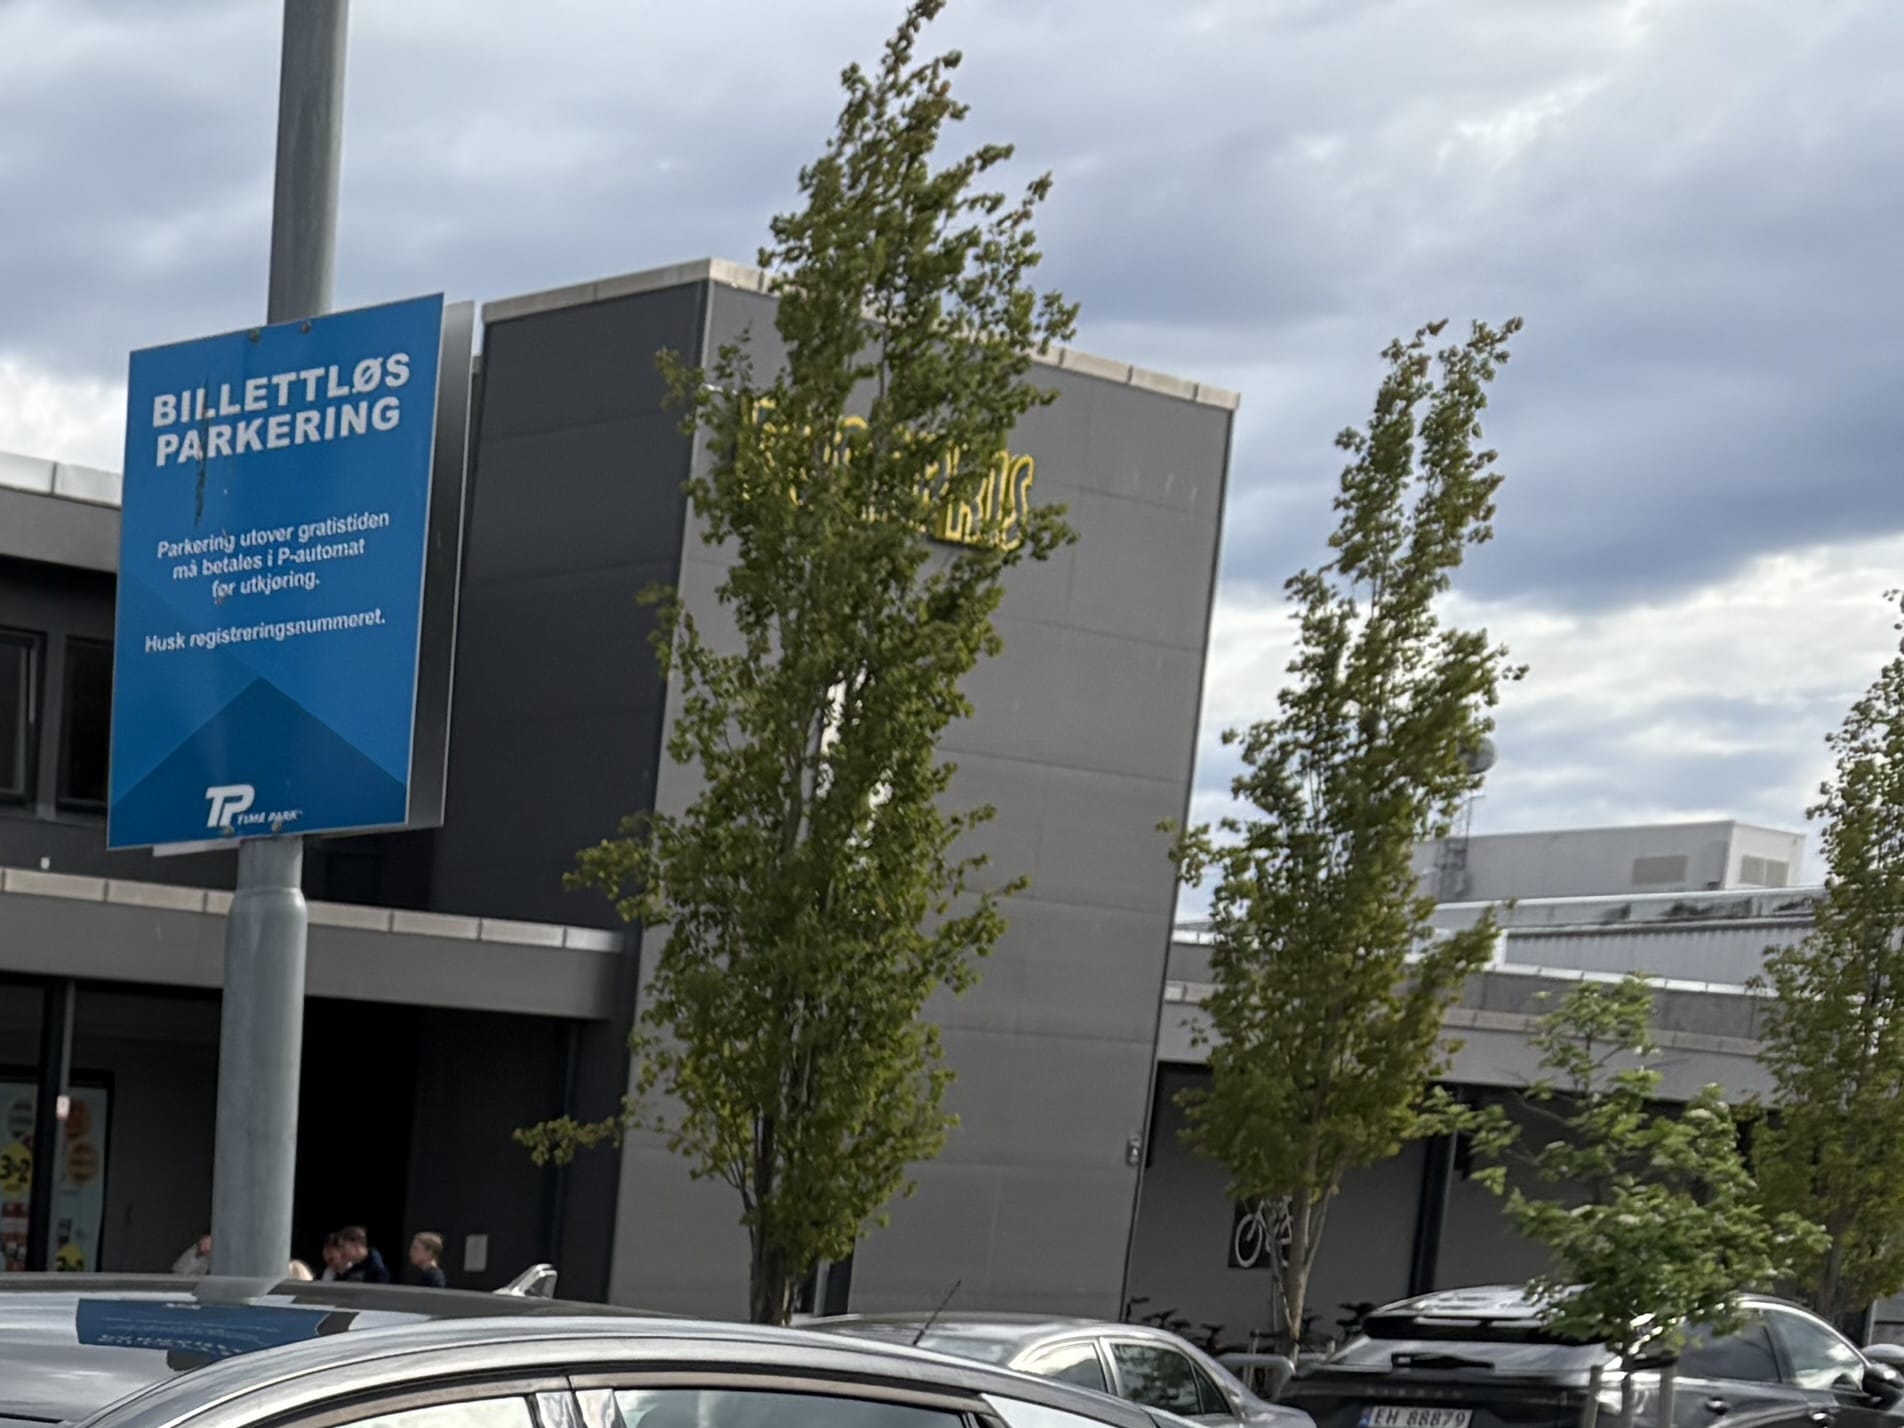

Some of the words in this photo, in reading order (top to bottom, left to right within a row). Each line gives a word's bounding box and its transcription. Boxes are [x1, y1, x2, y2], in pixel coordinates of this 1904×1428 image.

[152, 352, 411, 428] BILLETTLØS
[156, 396, 401, 467] PARKERING
[157, 533, 236, 559] Parkering
[240, 526, 295, 548] utover
[298, 511, 390, 543] gratistiden
[173, 561, 198, 580] må
[202, 554, 263, 576] betales
[267, 549, 273, 567] i
[278, 538, 365, 566] P-automat
[212, 580, 235, 600] før
[240, 570, 320, 595] utkjøring.
[145, 632, 185, 653] Husk
[190, 607, 386, 650] registreringsnummeret.
